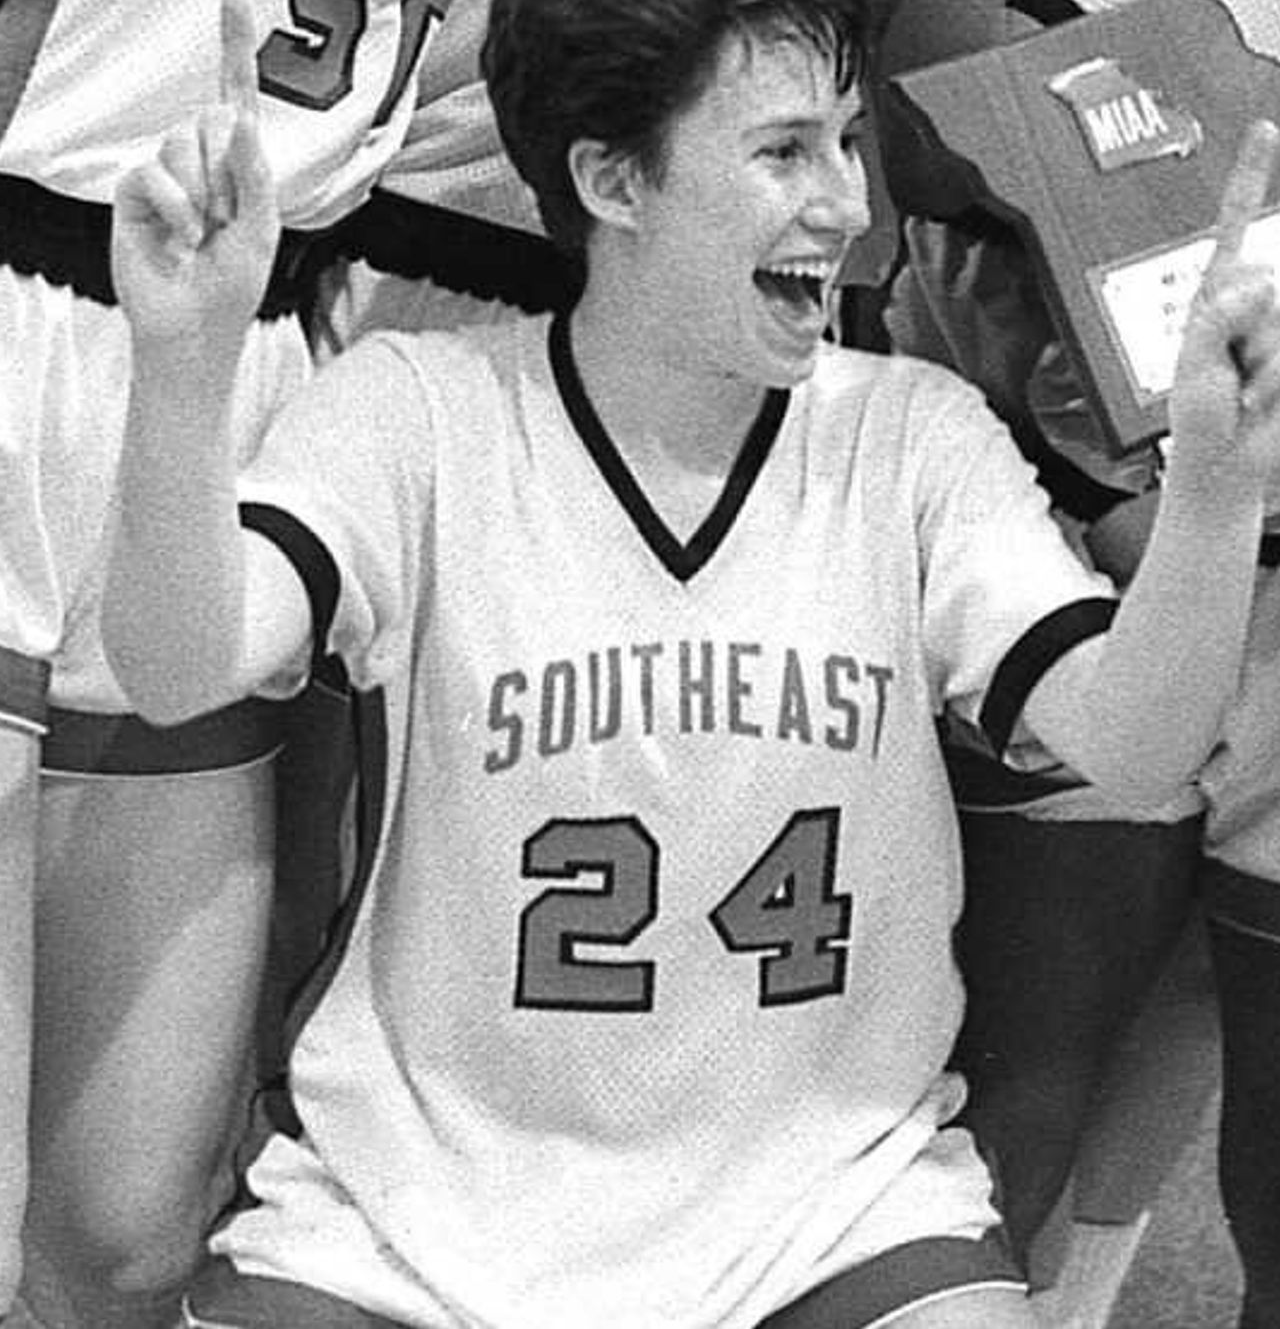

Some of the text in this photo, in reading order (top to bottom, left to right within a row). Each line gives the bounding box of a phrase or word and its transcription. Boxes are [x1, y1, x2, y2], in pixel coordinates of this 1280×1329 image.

[1085, 88, 1169, 153] MIAA
[483, 640, 894, 774] SOUTHEAST
[513, 806, 853, 1013] 24
